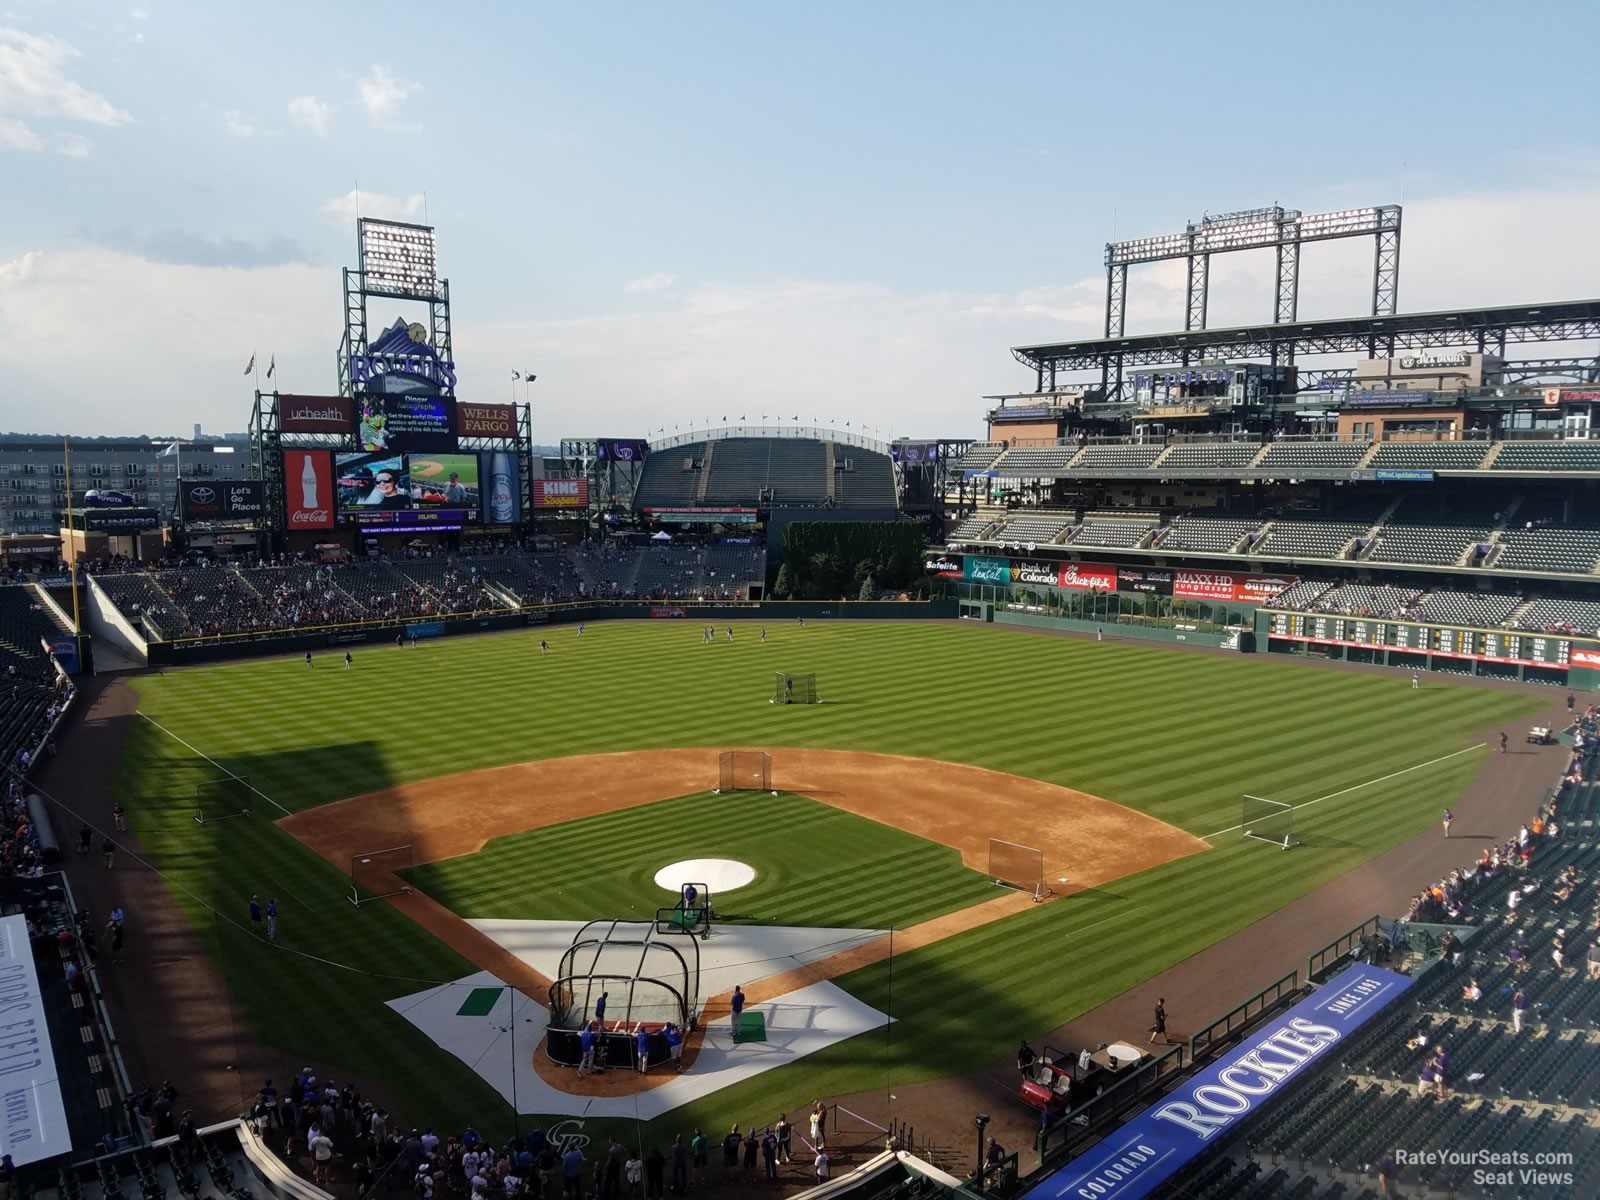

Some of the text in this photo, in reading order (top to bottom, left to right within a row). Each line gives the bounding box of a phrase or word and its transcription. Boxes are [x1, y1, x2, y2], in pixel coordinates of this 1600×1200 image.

[351, 355, 458, 389] ROCKIES
[1164, 368, 1234, 386] ROOFTOP
[397, 402, 436, 410] Autographs
[291, 406, 342, 420] uchealth
[463, 408, 509, 420] WELLS
[465, 420, 509, 432] FARGO
[1377, 472, 1433, 480] OfficeLiquidators.com
[544, 482, 578, 494] KING
[98, 494, 122, 503] TOYOTA
[232, 503, 261, 511] Places
[90, 518, 155, 527] TUNDRA
[926, 561, 958, 570] Safelite
[1020, 562, 1050, 573] Bank of
[972, 568, 1002, 580] dental
[1020, 573, 1058, 584] Colorado
[1176, 573, 1233, 586] MAXX HD
[1176, 583, 1232, 592] sunglasses
[1328, 979, 1382, 1013] SINCE 1993
[1152, 1017, 1342, 1140] ROCKIES
[1078, 1144, 1156, 1200] COLORADO
